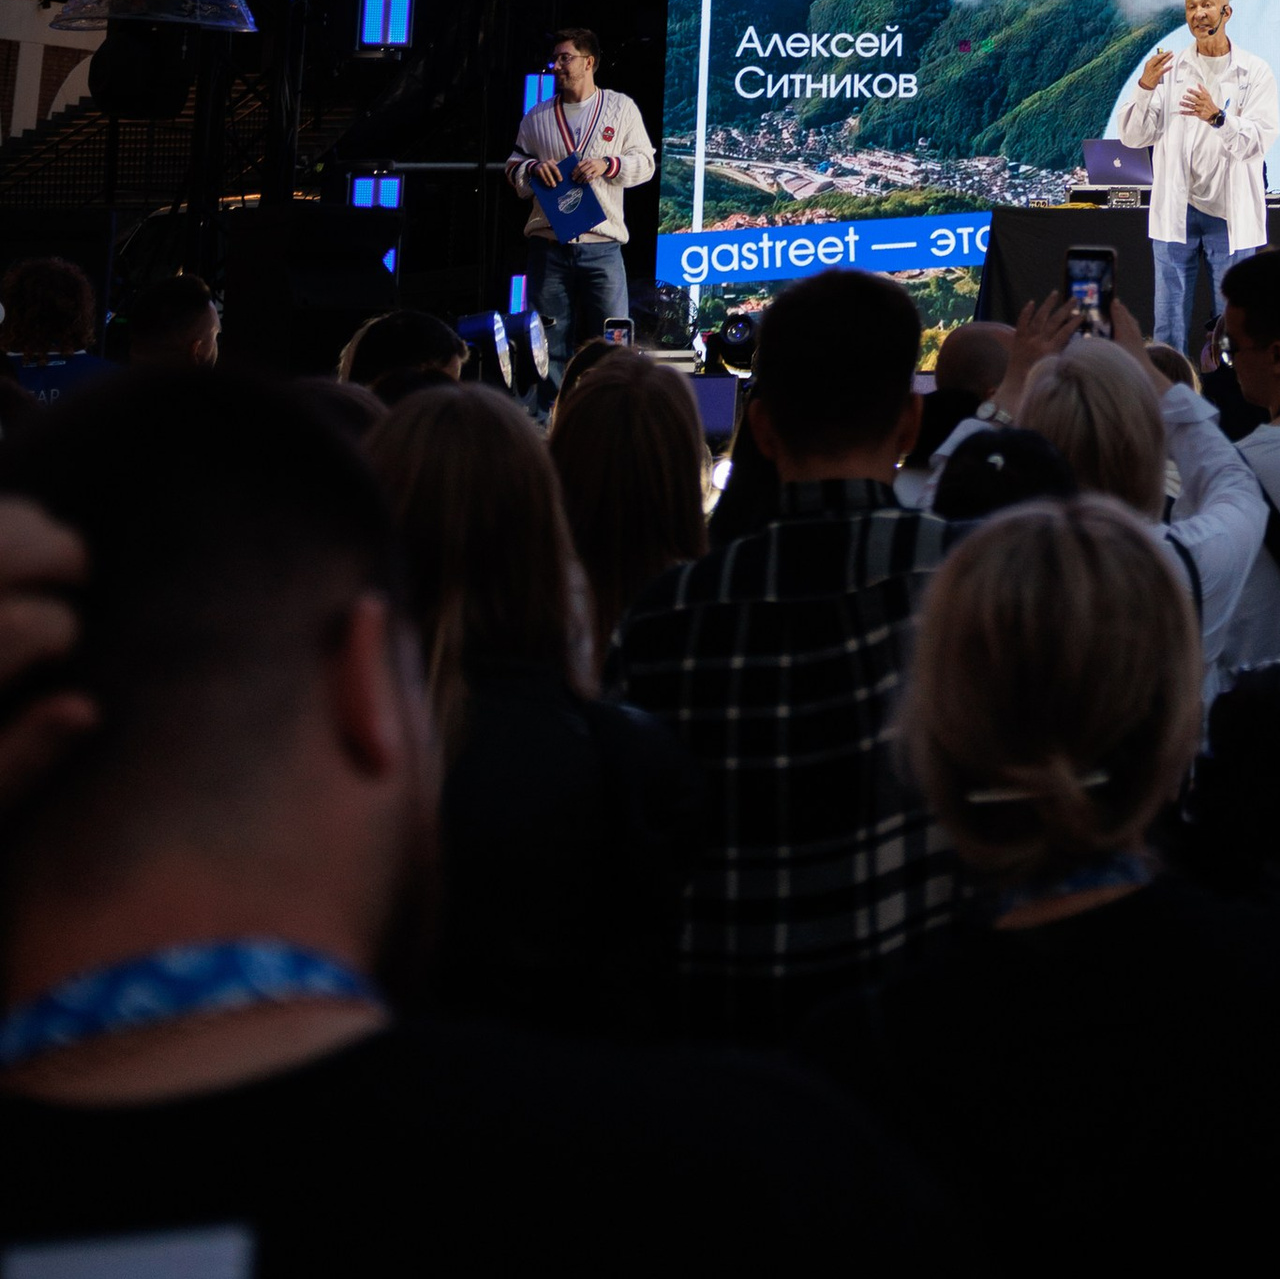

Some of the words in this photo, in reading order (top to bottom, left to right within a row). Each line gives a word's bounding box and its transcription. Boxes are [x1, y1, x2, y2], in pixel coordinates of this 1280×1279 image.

[735, 25, 904, 59] Алексей
[734, 66, 919, 99] Ситников
[681, 226, 860, 283] gastreet
